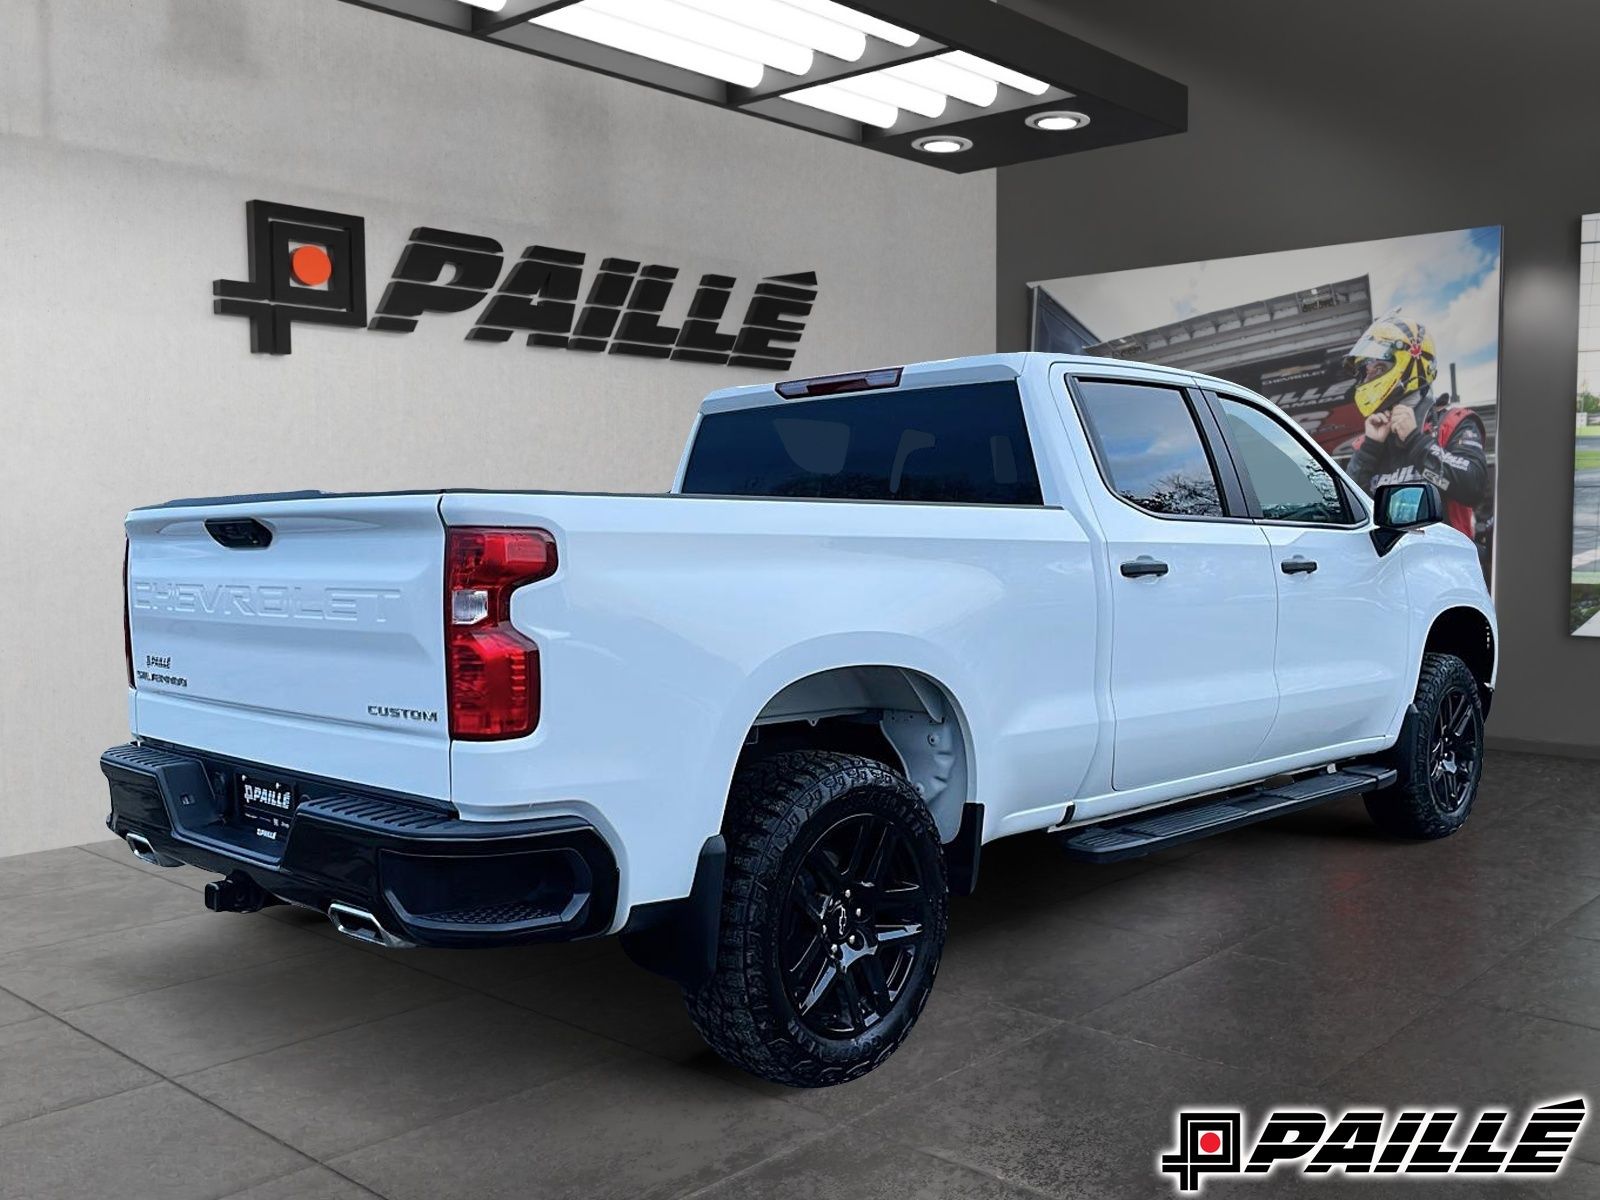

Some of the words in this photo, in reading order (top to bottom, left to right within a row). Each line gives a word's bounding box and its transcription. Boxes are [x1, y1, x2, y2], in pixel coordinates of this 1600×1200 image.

[368, 226, 818, 371] PAILLÉ
[1261, 370, 1326, 386] CHEVROLET
[133, 583, 401, 623] CHEVROLET
[136, 670, 188, 687] SILVERADO
[367, 705, 438, 722] CUSTOM
